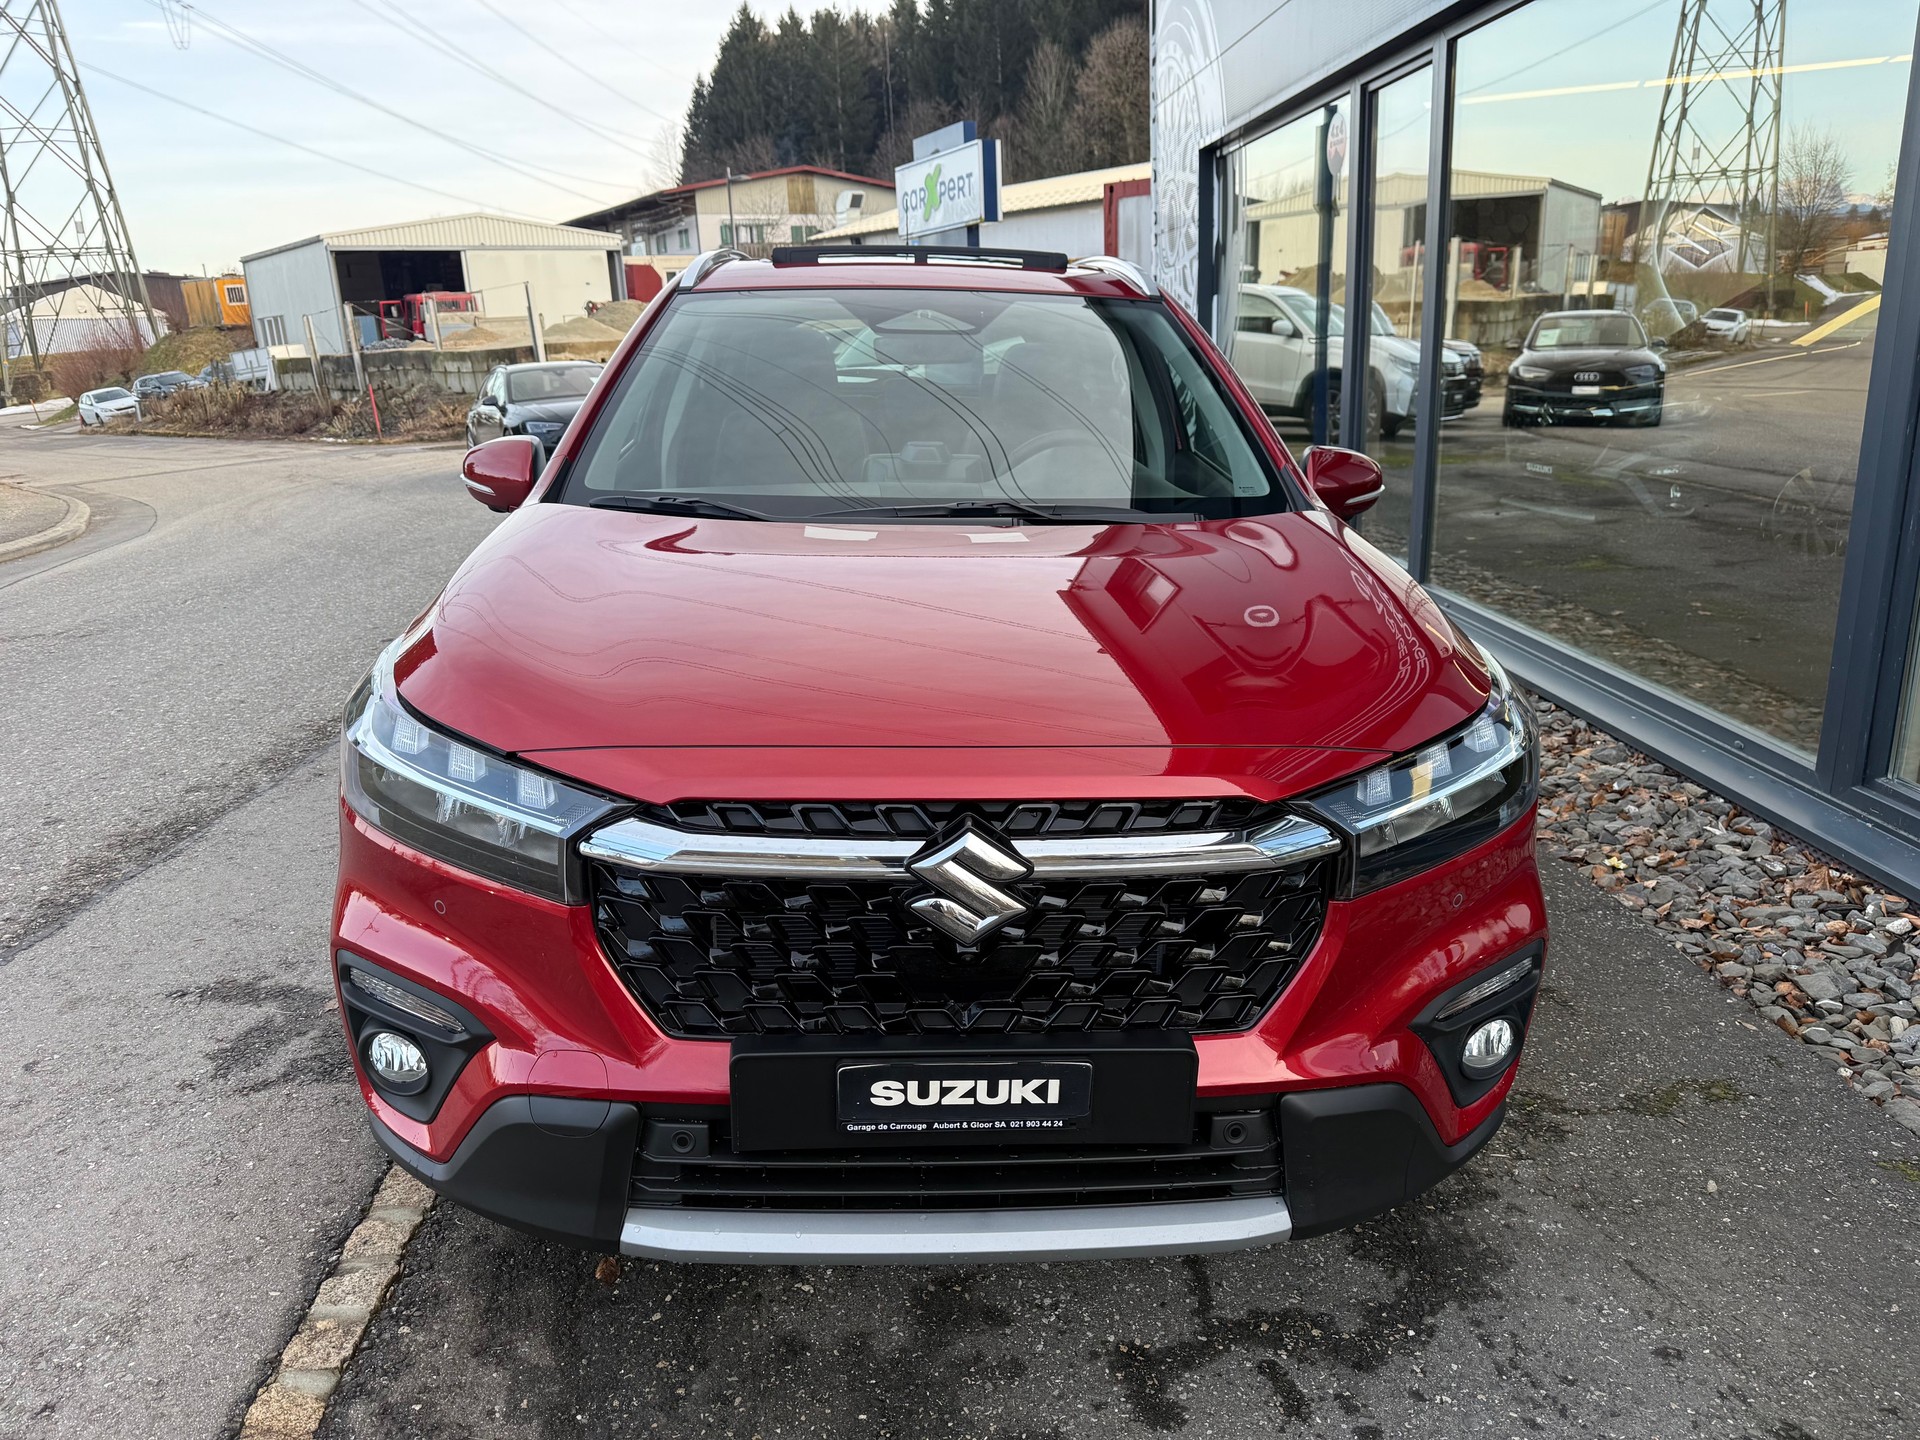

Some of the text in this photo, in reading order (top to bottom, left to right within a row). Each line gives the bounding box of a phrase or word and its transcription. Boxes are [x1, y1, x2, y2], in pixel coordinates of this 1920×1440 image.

[1526, 462, 1553, 474] SUZUKI
[870, 1079, 1060, 1106] SUZUKI
[890, 1122, 927, 1131] Carrouge
[962, 1121, 968, 1129] &
[1010, 1120, 1024, 1128] 021
[1026, 1120, 1040, 1128] 903
